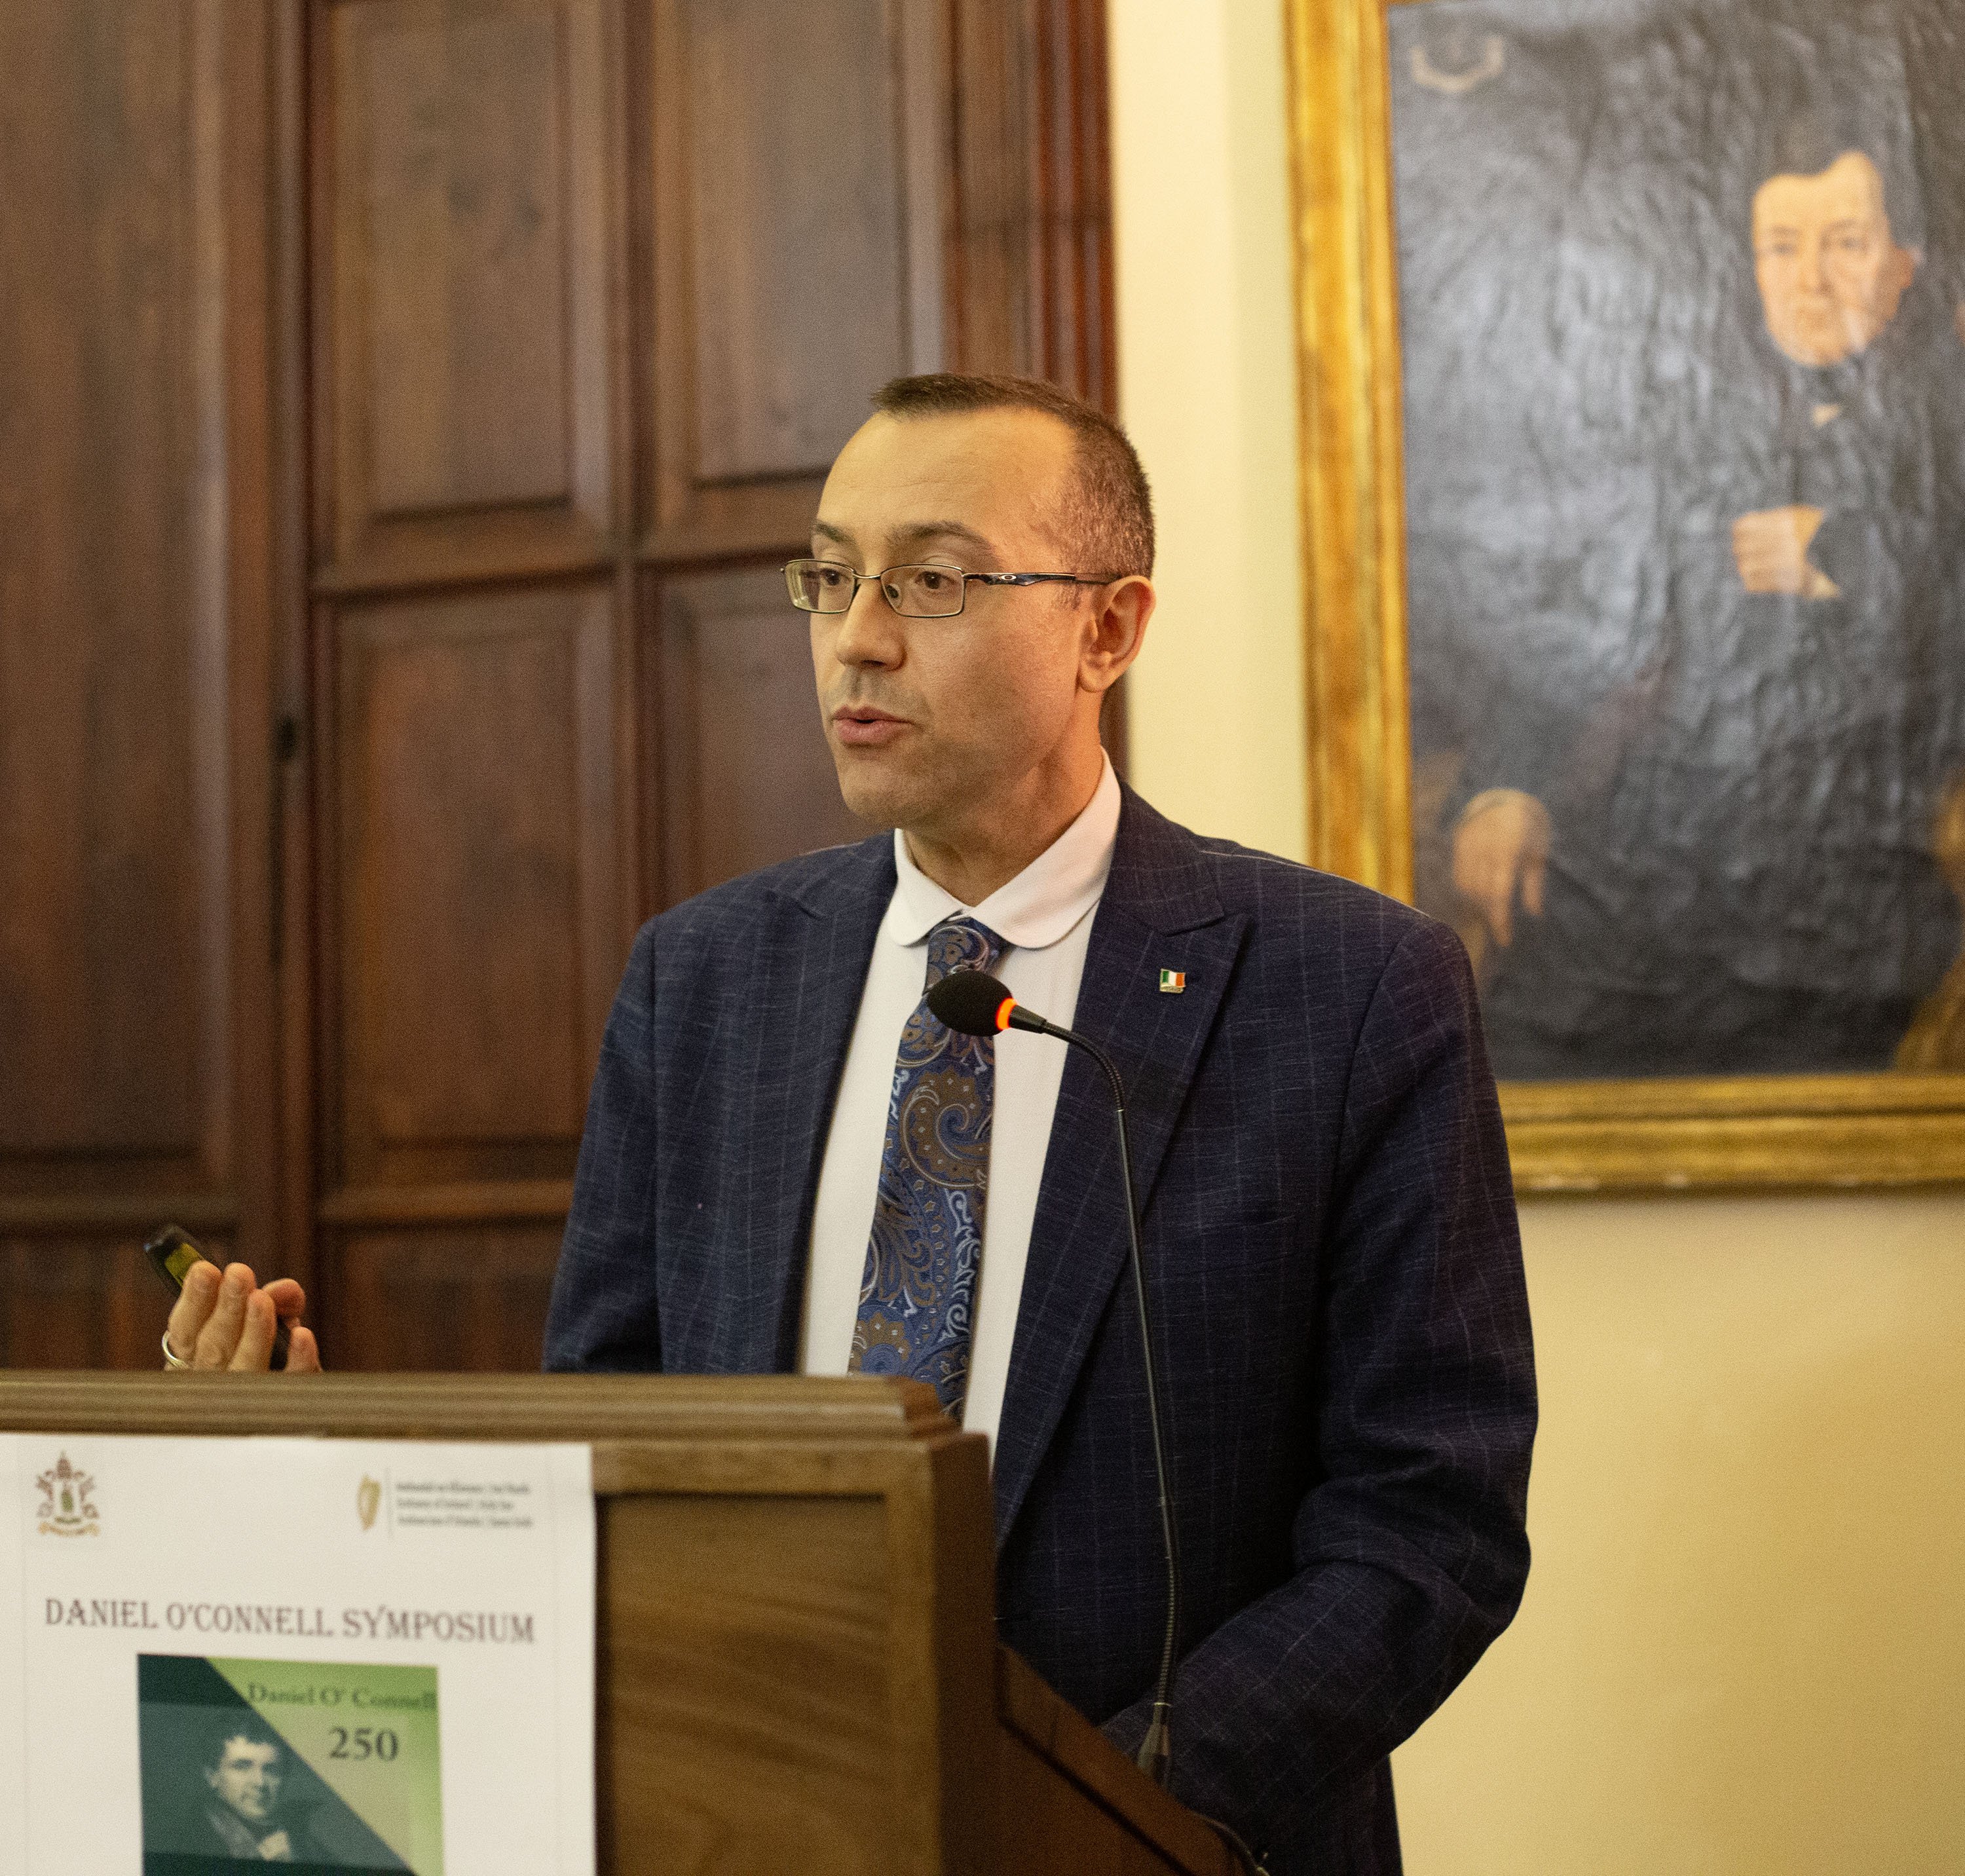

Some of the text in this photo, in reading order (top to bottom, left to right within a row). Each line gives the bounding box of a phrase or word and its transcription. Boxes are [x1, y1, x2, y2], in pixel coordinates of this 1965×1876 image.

[45, 1598, 535, 1643] DANIEL O'CONNELL SYMPOSIUM
[248, 1682, 315, 1706] Daniel
[329, 1725, 399, 1762] 250
